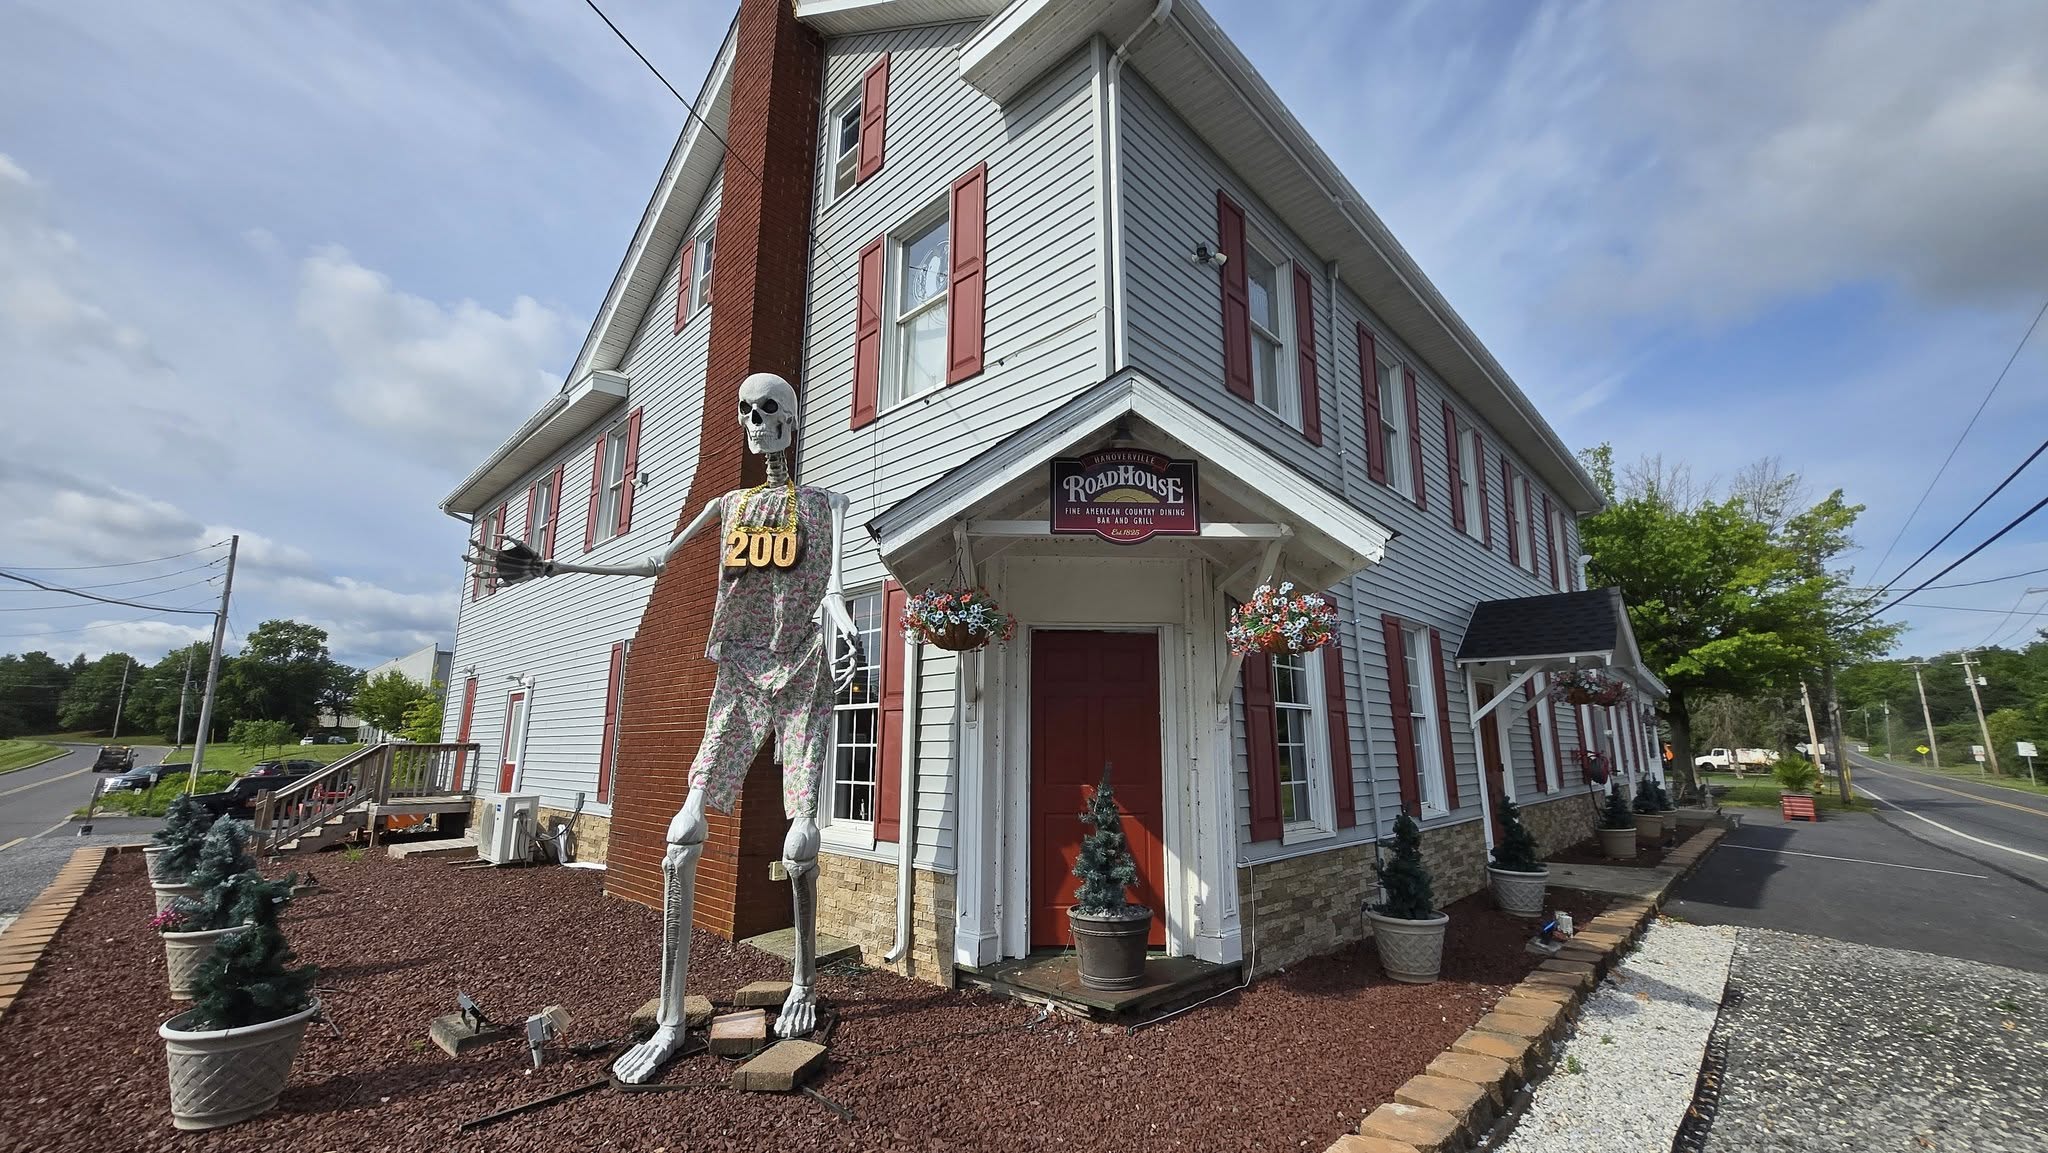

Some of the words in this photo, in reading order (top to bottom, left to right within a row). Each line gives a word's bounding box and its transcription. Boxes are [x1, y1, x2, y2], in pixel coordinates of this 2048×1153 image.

[1094, 453, 1155, 464] HANOVERVILLE
[1065, 507, 1081, 515] FINE
[1086, 507, 1120, 515] AMERICAN
[1124, 508, 1155, 516] COUNTRY
[1160, 508, 1185, 516] DINING
[1115, 517, 1128, 525] AND
[1134, 517, 1153, 525] GRILL
[725, 531, 797, 567] 200
